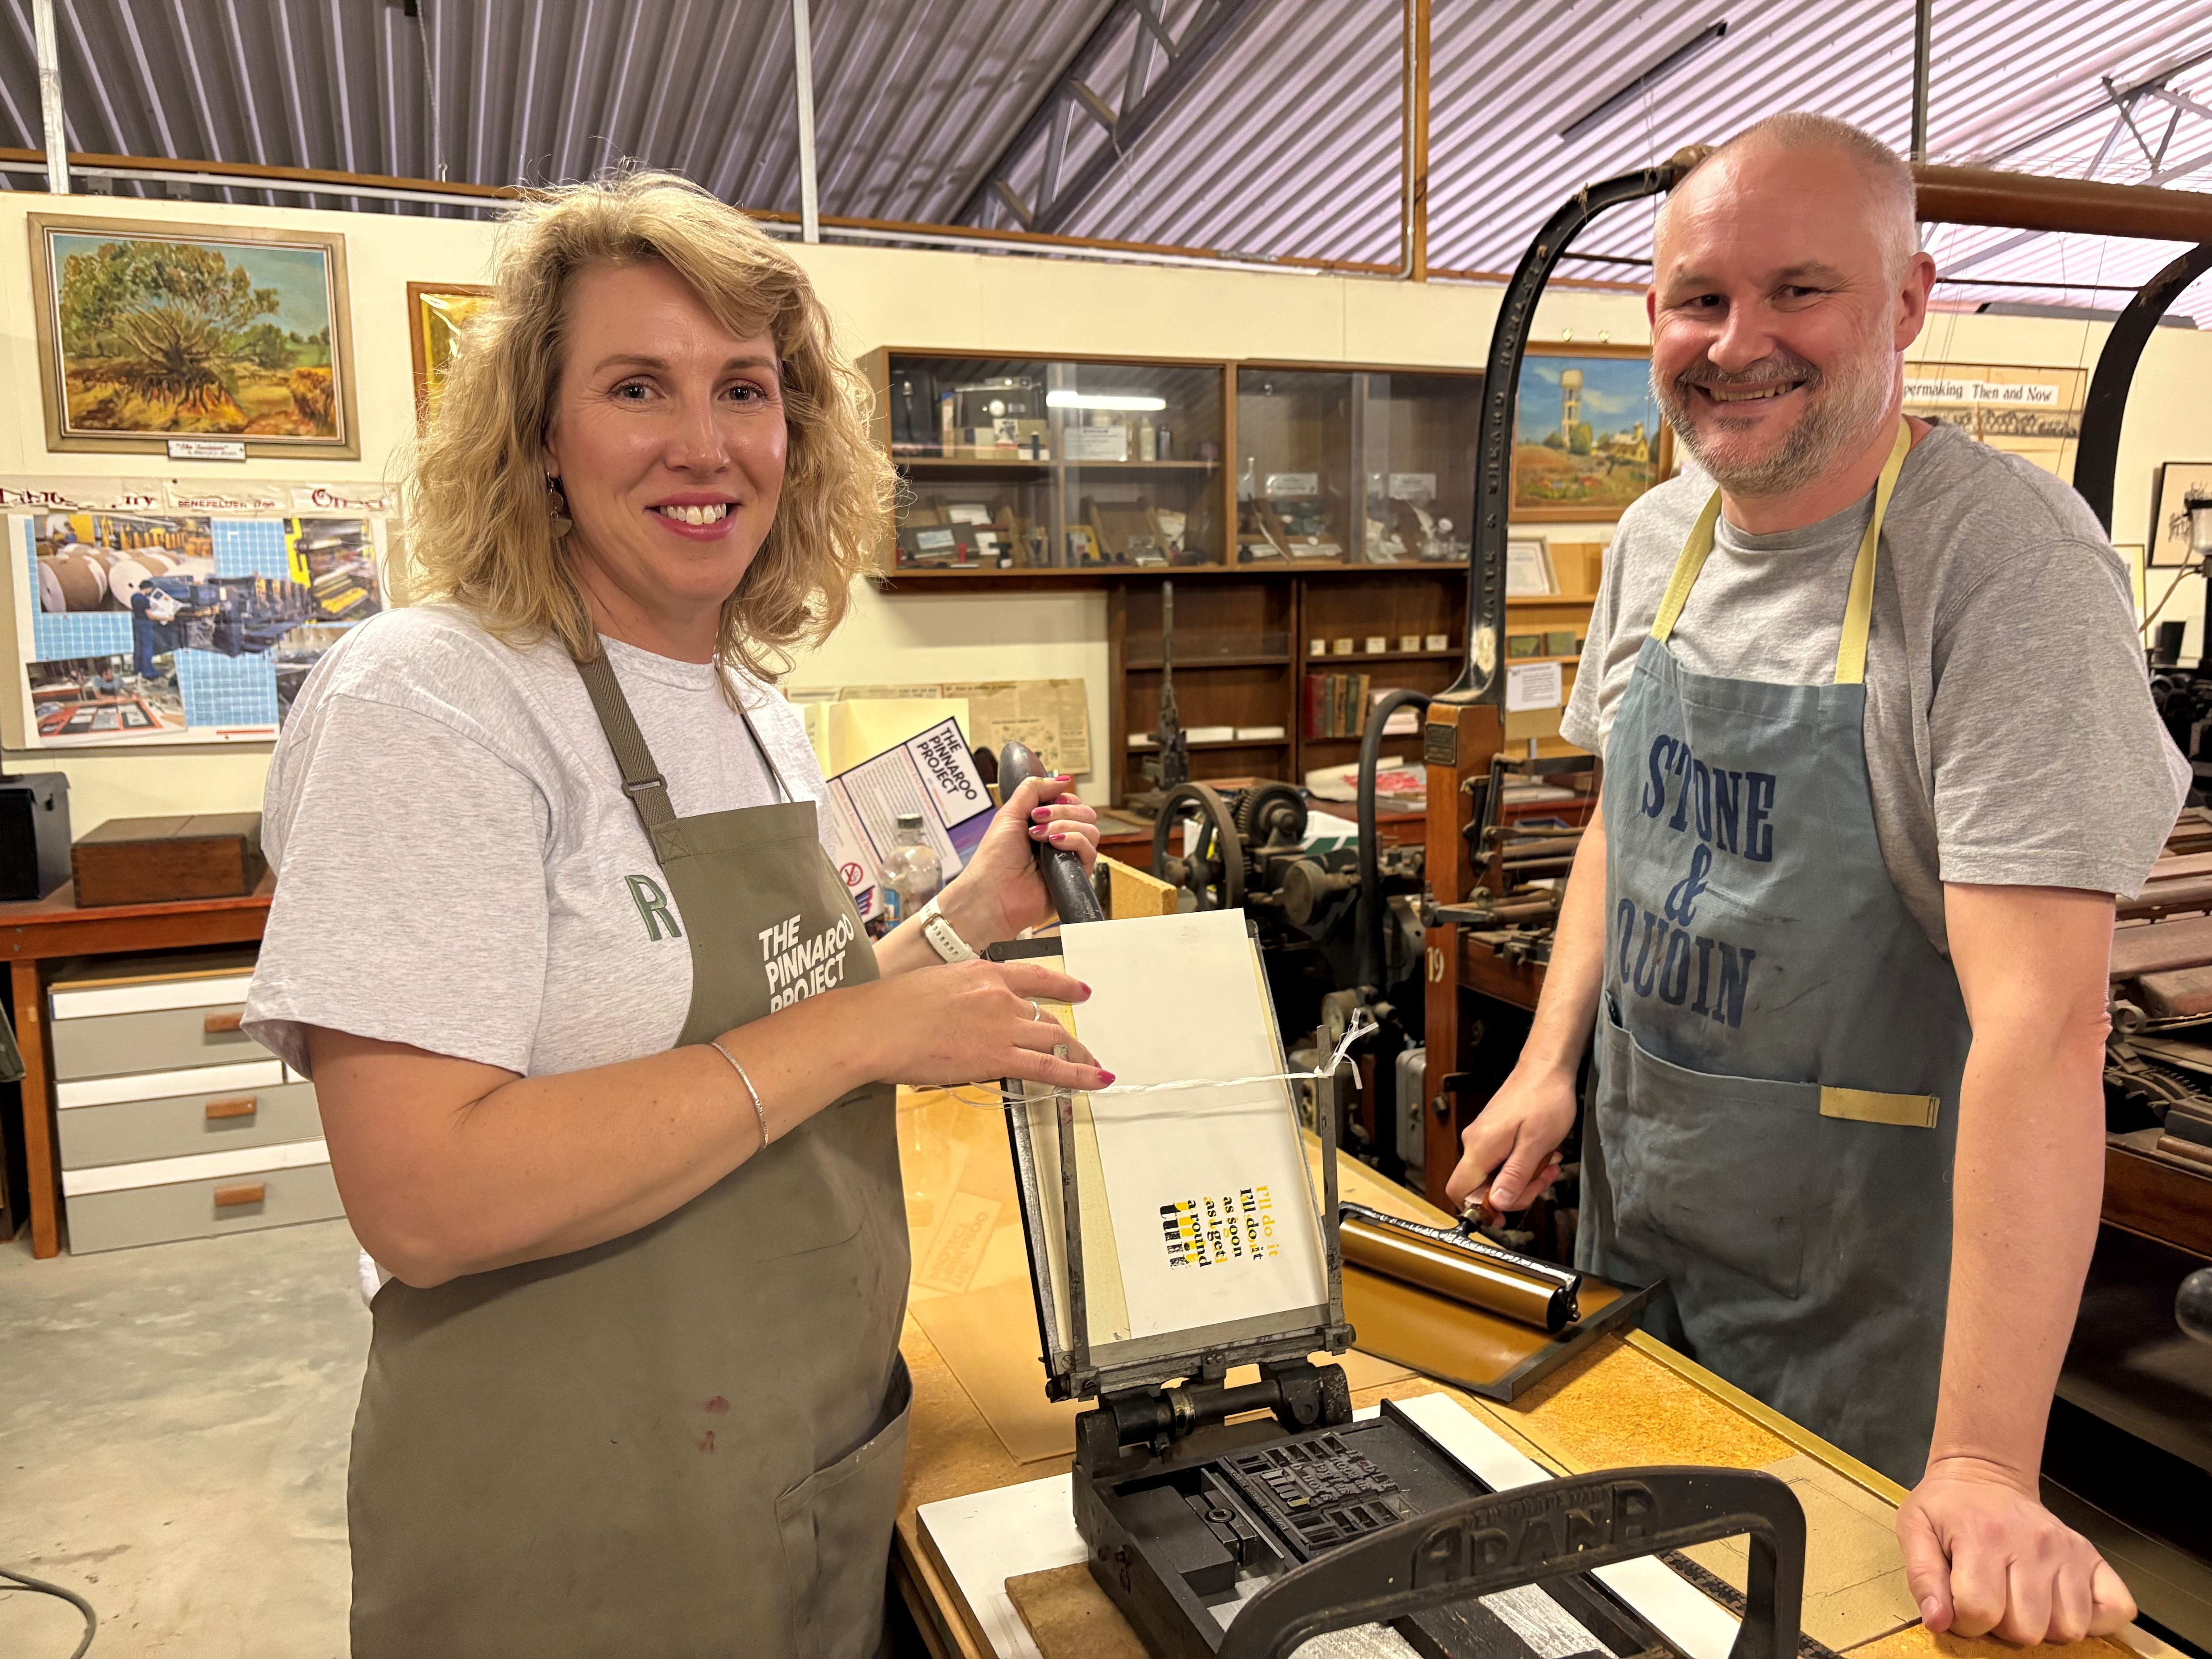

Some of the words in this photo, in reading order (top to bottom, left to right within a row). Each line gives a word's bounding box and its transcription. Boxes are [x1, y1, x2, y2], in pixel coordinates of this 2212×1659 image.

[1904, 381, 1963, 401] permaking
[1972, 384, 1999, 399] Then
[2003, 385, 2023, 399] and
[2027, 386, 2052, 402] Now
[940, 727, 962, 753] THE
[917, 742, 959, 794] PROJECT
[929, 735, 977, 800] PINNAROO
[1641, 735, 1776, 862] STONE
[1665, 843, 1713, 927] &
[624, 875, 682, 941] R
[759, 914, 801, 961] THE
[765, 914, 854, 995] PINNAROO
[771, 950, 845, 1014] PROJECT
[1427, 947, 1444, 983] 19
[1187, 1200, 1196, 1209] a
[1206, 1201, 1216, 1217] as
[1224, 1196, 1234, 1213] as
[1190, 1213, 1211, 1267] round
[1207, 1230, 1226, 1258] get
[1227, 1217, 1241, 1257] soon
[1246, 1217, 1259, 1240] do
[1252, 1246, 1263, 1260] it
[1411, 1479, 1656, 1589] ADANA
